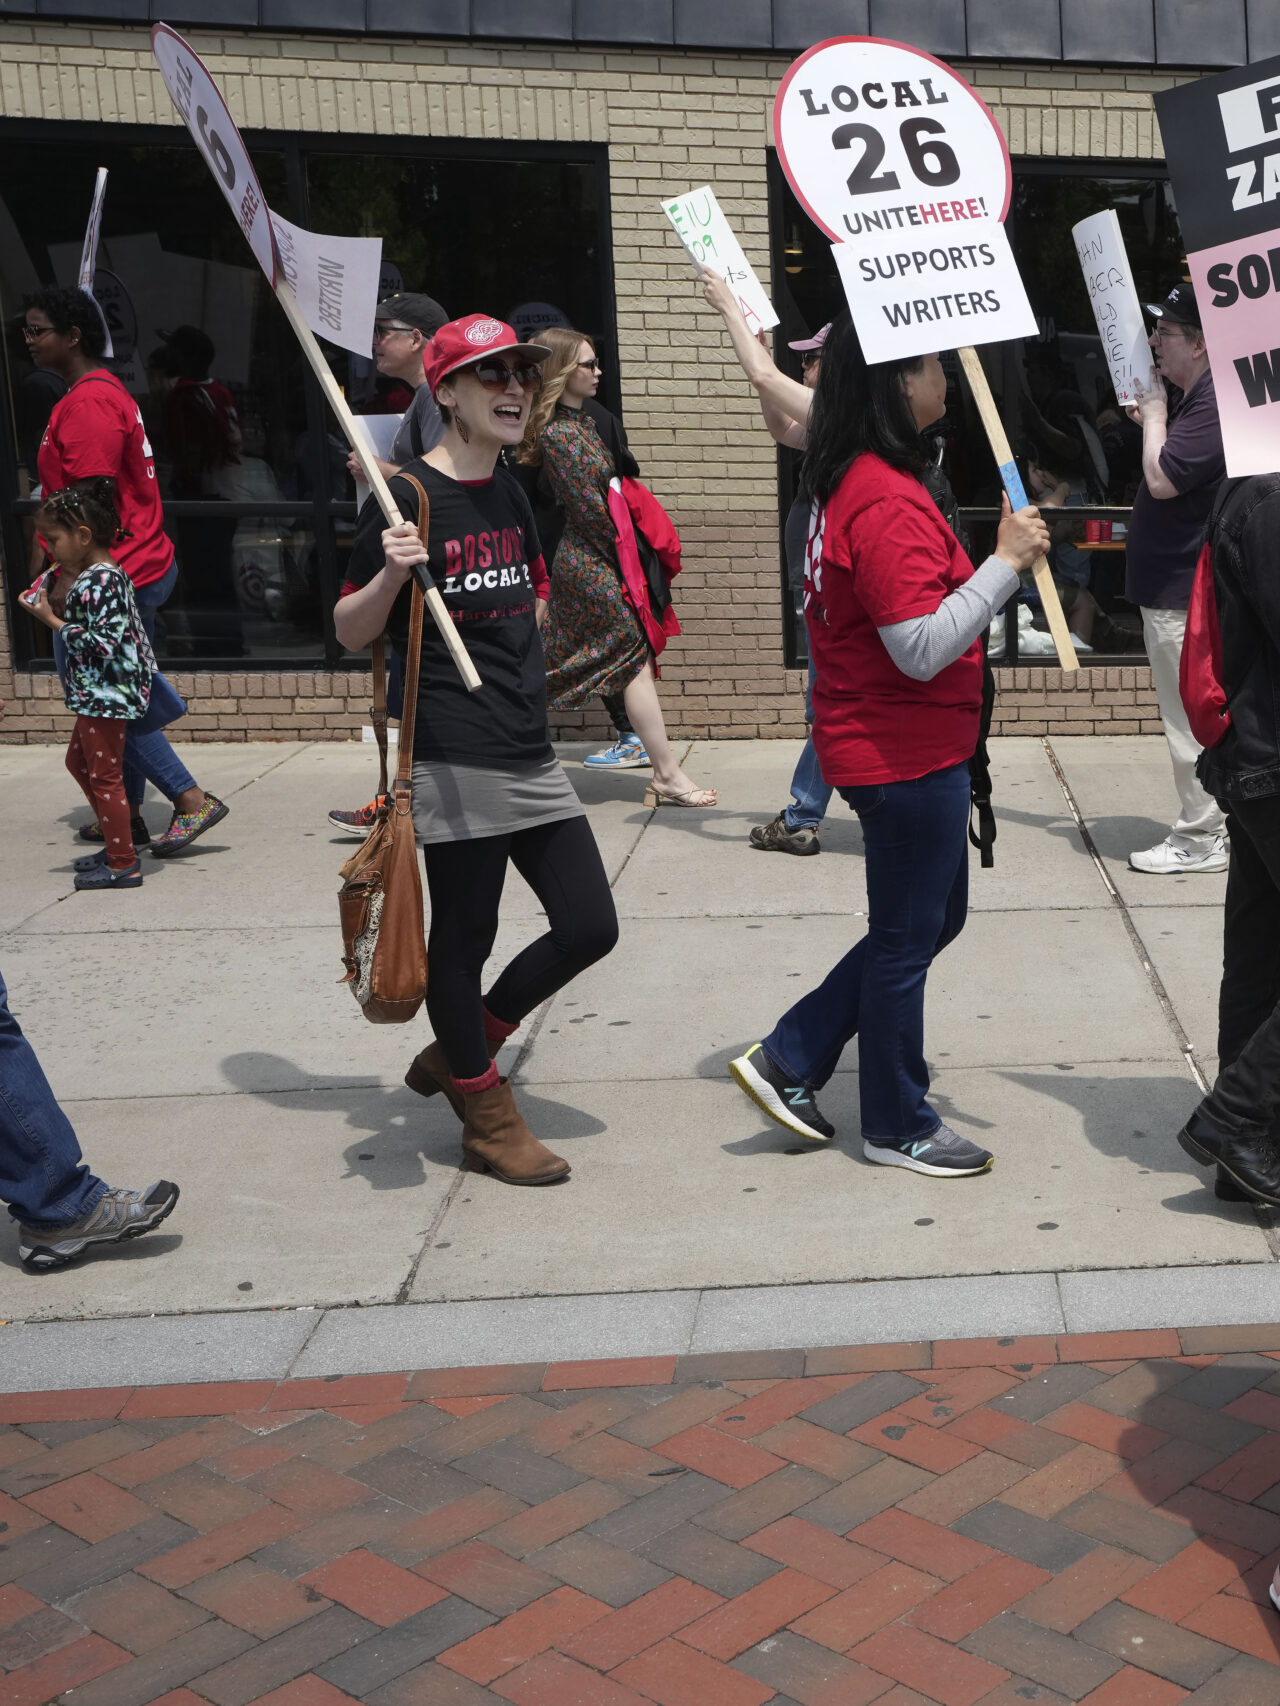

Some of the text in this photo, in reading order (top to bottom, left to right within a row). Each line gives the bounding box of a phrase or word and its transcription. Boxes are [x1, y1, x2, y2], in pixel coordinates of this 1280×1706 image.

[175, 55, 194, 121] CAL
[798, 77, 949, 117] LOCAL
[196, 104, 236, 191] 6
[830, 116, 961, 196] 26
[668, 193, 713, 236] EIU
[842, 196, 989, 235] UNITEHERE!
[858, 242, 996, 282] SUPPORTS
[881, 289, 1001, 328] WRITERS
[443, 566, 521, 594] LOCAL
